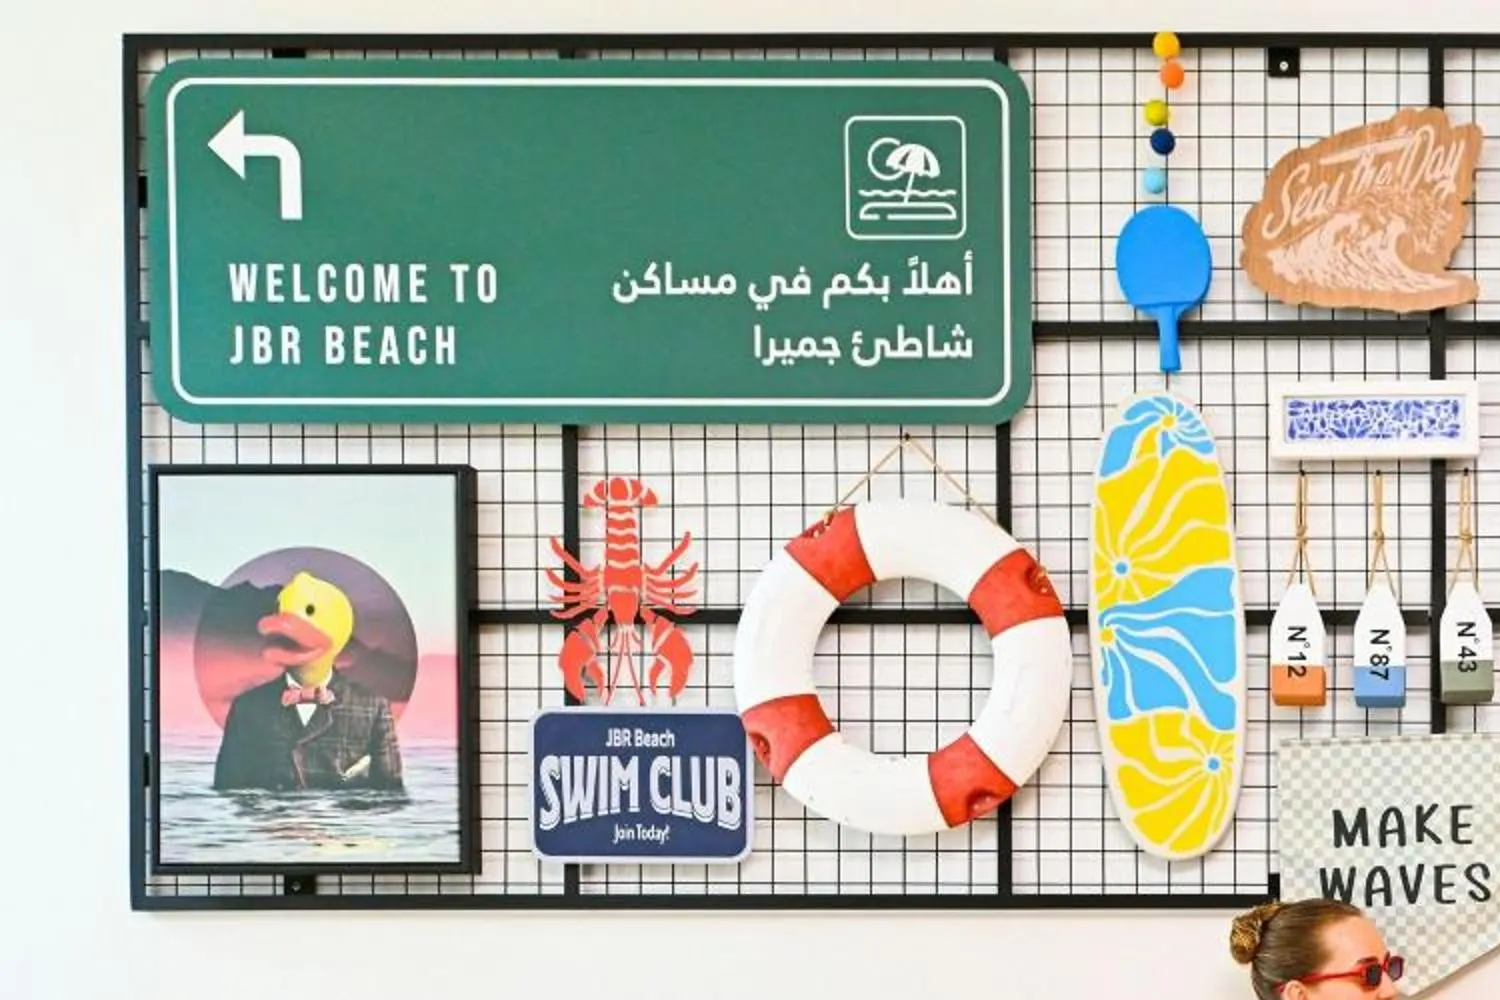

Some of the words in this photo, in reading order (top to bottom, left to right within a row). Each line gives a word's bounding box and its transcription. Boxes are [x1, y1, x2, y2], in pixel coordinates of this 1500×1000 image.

[1397, 125, 1465, 199] Day
[229, 263, 427, 303] WELCOME
[449, 263, 498, 303] TO
[612, 261, 737, 303] مساكن
[748, 266, 811, 311] في
[822, 262, 890, 309] بكم
[902, 250, 973, 295] أهلاً
[230, 325, 301, 365] JBR
[325, 325, 457, 365] BEACH
[753, 324, 841, 366] جميرا
[851, 323, 973, 367] شاطئ
[605, 728, 632, 747] JBR
[634, 728, 675, 747] Beach
[539, 755, 641, 830] SWIM
[650, 755, 742, 830] CLUB
[613, 824, 635, 845] Join
[635, 825, 670, 845] Today!
[1332, 803, 1474, 848] MAKE
[1319, 862, 1492, 907] WAVES
